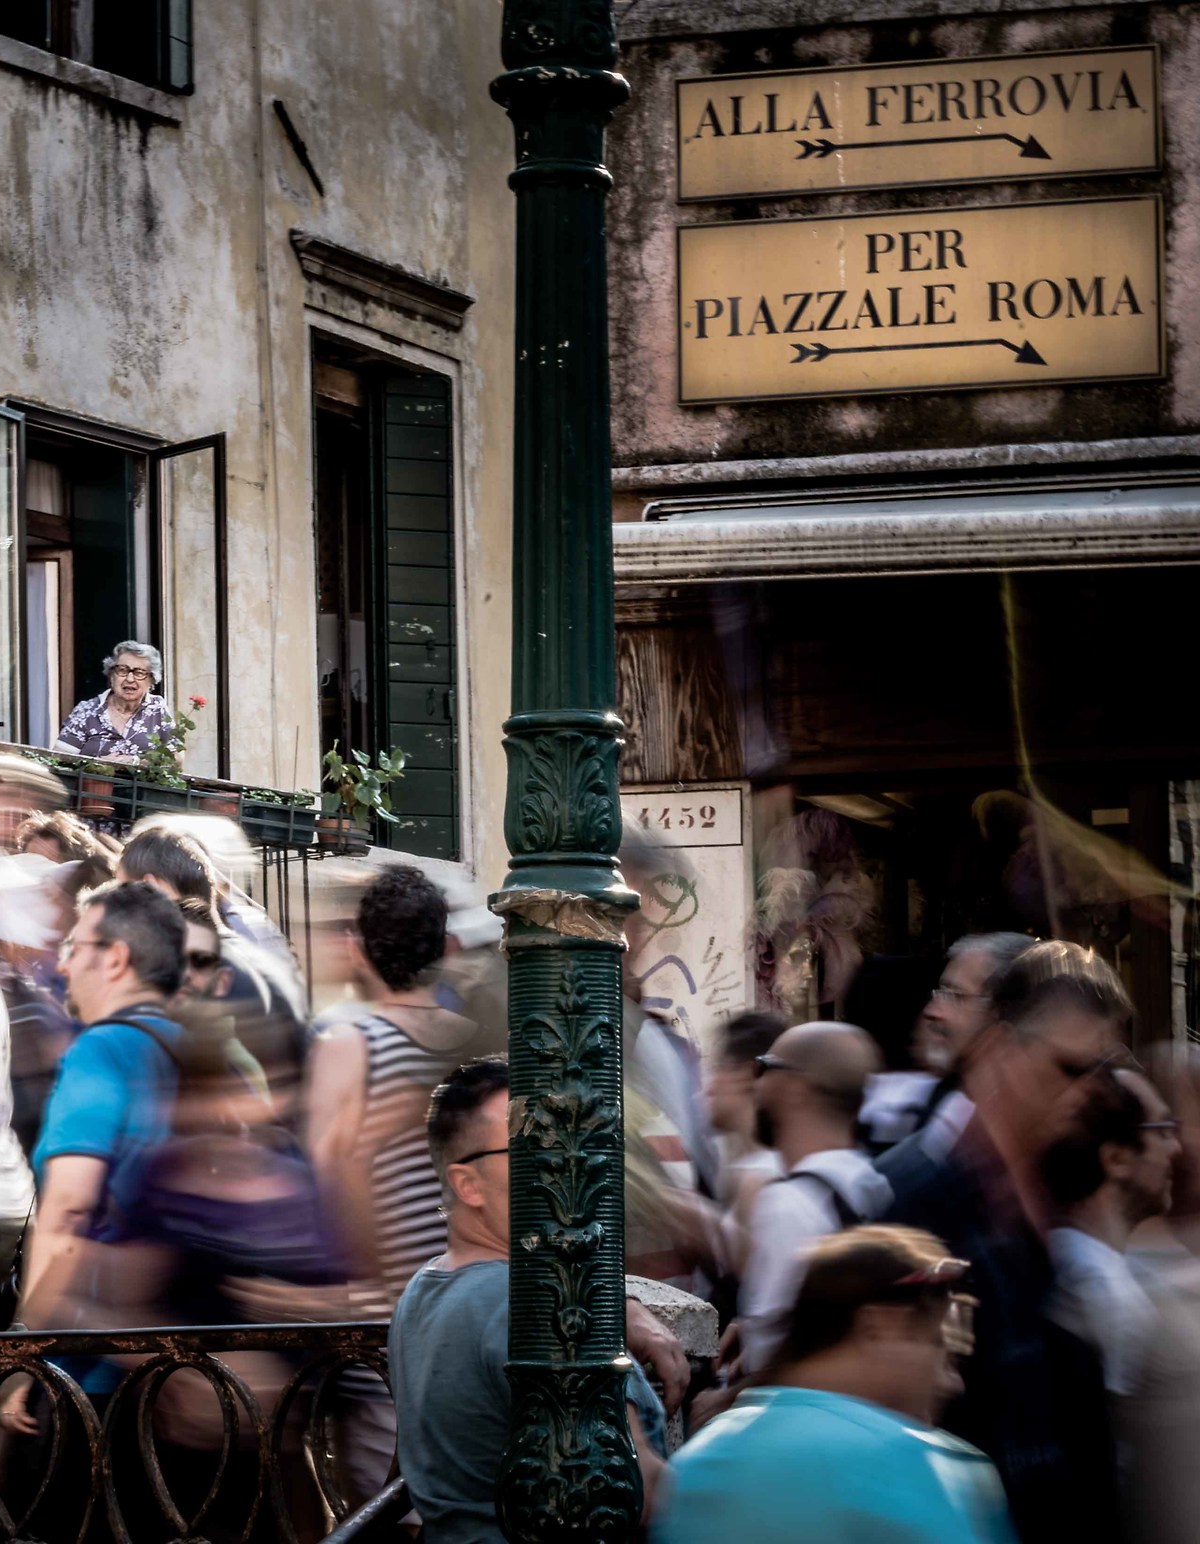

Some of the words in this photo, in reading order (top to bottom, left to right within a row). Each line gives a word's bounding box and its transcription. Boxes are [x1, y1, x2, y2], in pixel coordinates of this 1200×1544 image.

[692, 91, 833, 139] ALLA
[865, 69, 1141, 126] FERROVIA
[865, 228, 967, 274] PER
[693, 283, 957, 339] PIAZZALE
[987, 275, 1144, 322] ROMA
